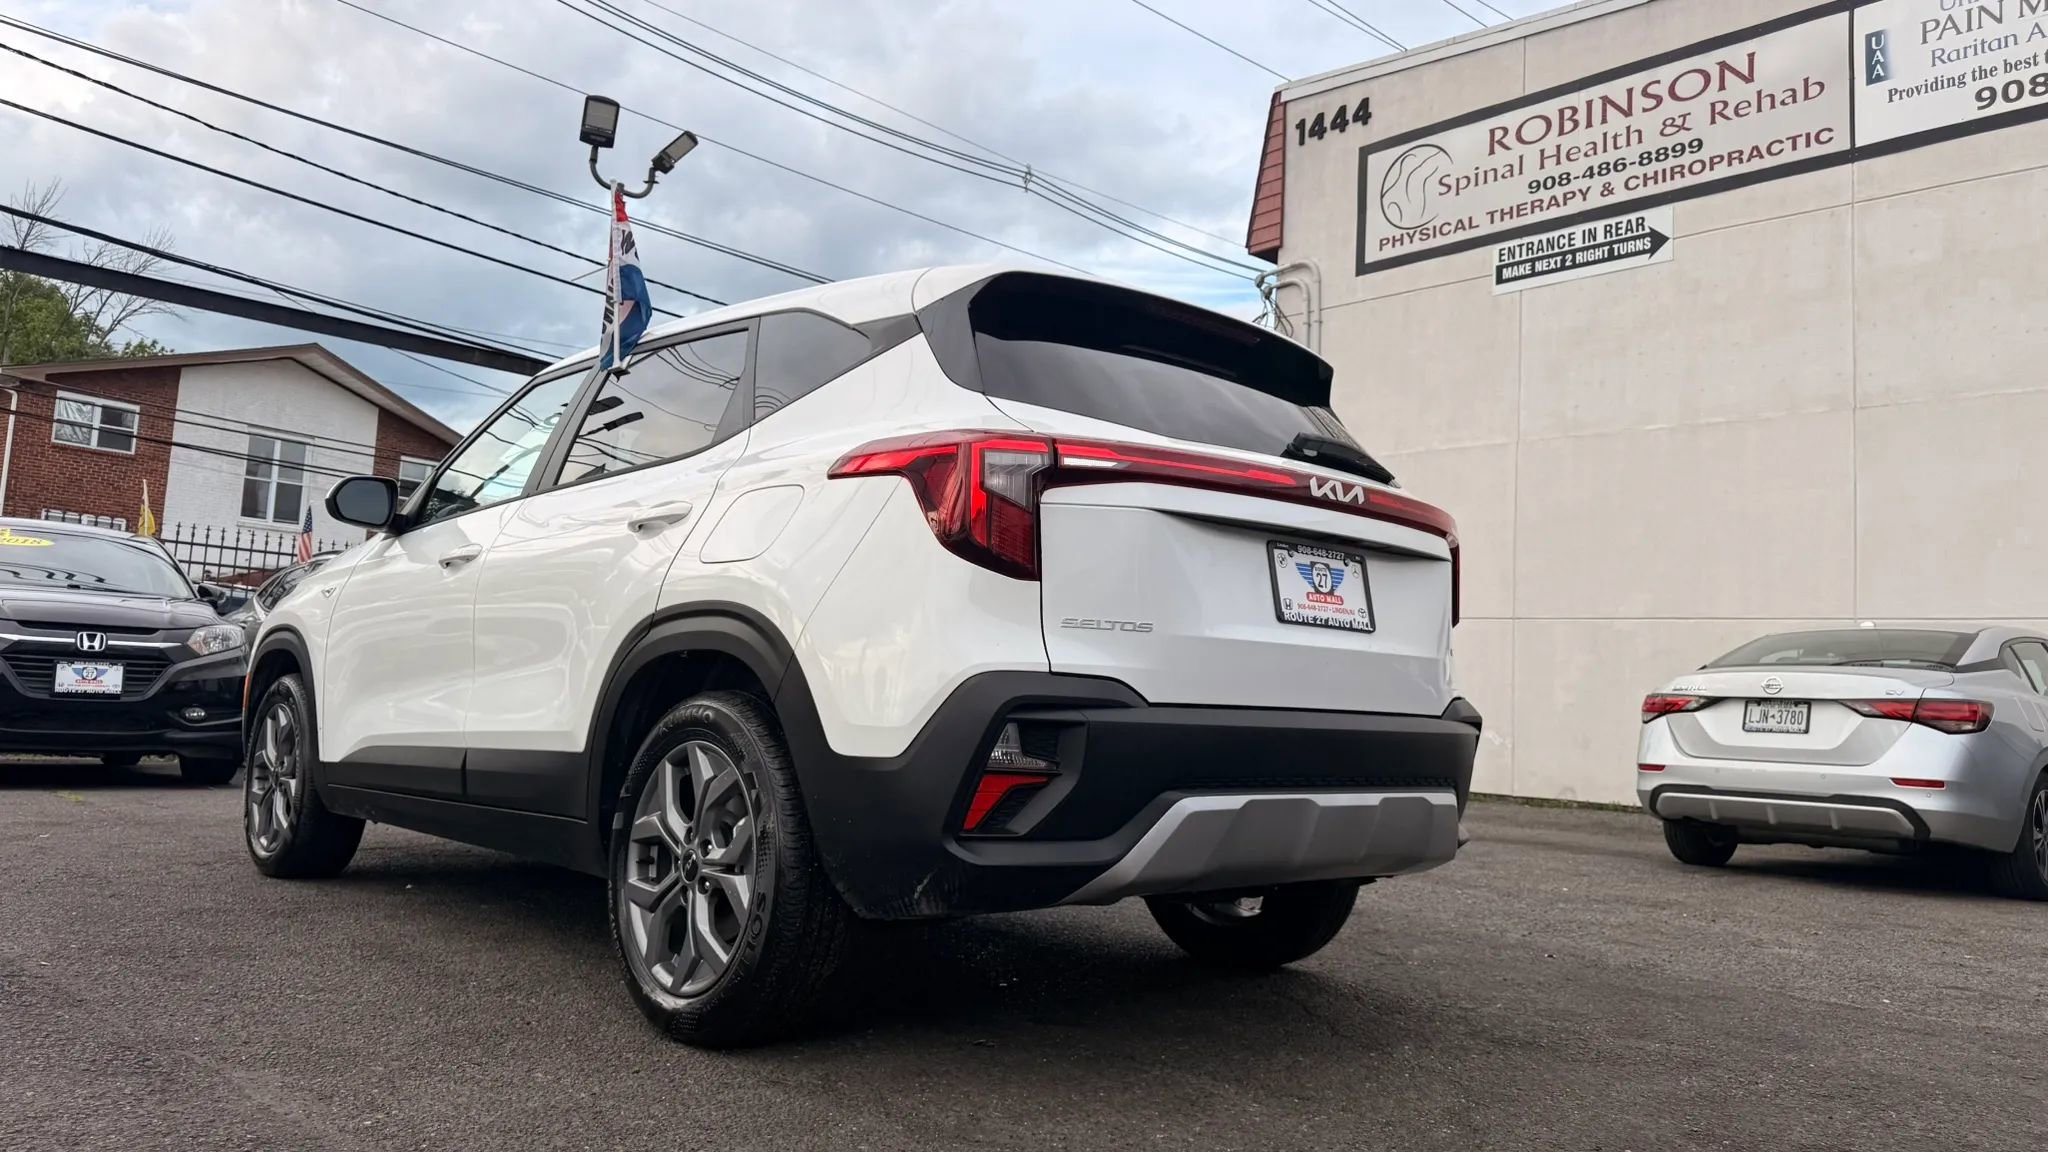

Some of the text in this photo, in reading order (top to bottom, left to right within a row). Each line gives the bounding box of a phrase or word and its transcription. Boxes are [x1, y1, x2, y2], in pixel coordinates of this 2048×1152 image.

[1921, 0, 2003, 45] PAIN
[1871, 34, 1885, 79] UAA
[1930, 33, 2018, 68] Raritan
[1887, 73, 1967, 104] Providing
[1971, 62, 1998, 82] the
[2003, 51, 2040, 75] best
[1295, 97, 1372, 146] 1444
[1488, 52, 1756, 156] ROBINSON
[1438, 76, 1826, 197] Spinal Health & Rehab
[1527, 137, 1704, 195] 908-486-8899
[1378, 127, 1835, 252] PHYSICAL THERAPY & CHIROPRACTIC
[1498, 216, 1646, 263] ENTRANCE IN REAR
[1502, 236, 1652, 280] MAKE NEXT 2 RIGHT TURNS
[1308, 593, 1343, 605] AUTO MALL
[1316, 572, 1328, 589] 27
[1060, 618, 1153, 633] SELTOS
[1284, 611, 1374, 631] ROUTE 27 AUTO MALL
